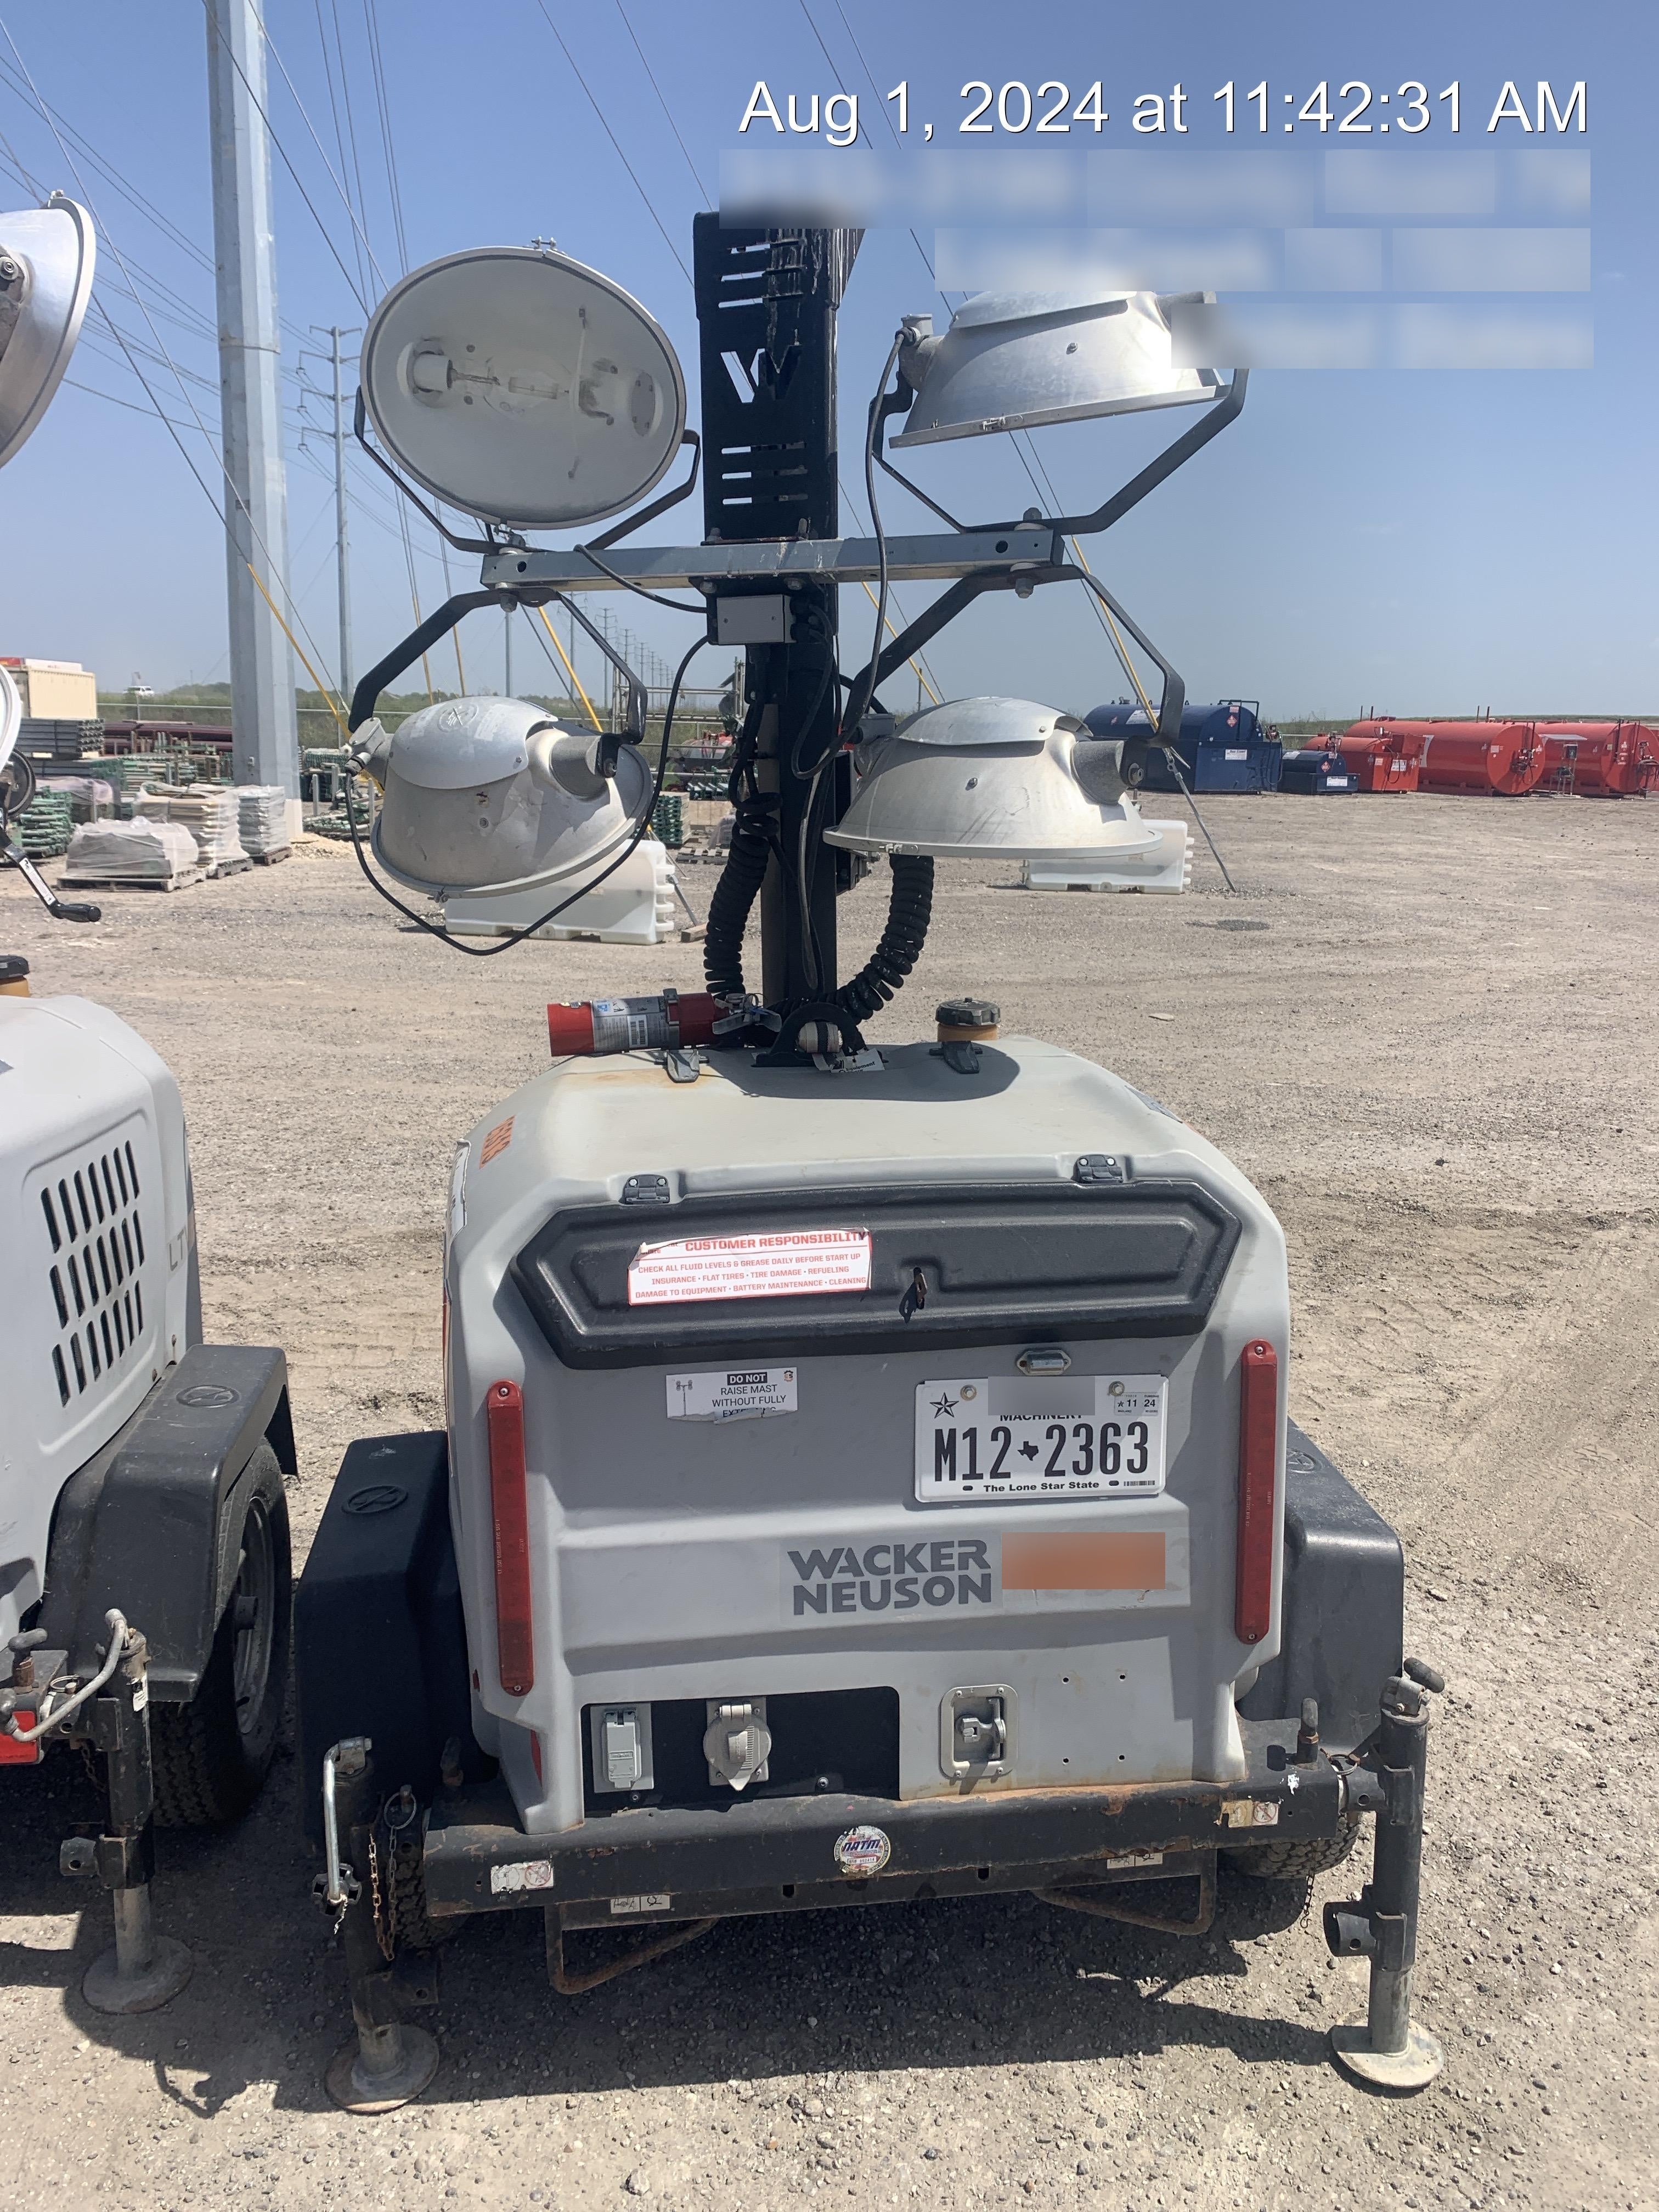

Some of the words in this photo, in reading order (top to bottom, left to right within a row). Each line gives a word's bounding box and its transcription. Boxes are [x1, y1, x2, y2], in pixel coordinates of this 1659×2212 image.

[170, 1229, 184, 1271] LT
[686, 1238, 755, 1251] CUSTOMER
[759, 1232, 866, 1247] RESPONSIBILITY
[741, 1259, 770, 1267] GREASE
[652, 1276, 696, 1285] INSURANCE
[770, 1269, 802, 1277] DAMAGE
[808, 1266, 849, 1274] REFUELING
[682, 1286, 727, 1295] EQUIPMENT
[733, 1283, 766, 1291] BATTERY
[769, 1280, 823, 1289] MAINTENANCE
[829, 1277, 866, 1285] CLEANING
[730, 1375, 743, 1384] DO
[746, 1374, 766, 1383] NOT
[721, 1386, 748, 1395] RAISE
[751, 1384, 777, 1393] MAST
[712, 1397, 756, 1407] WITHOUT
[759, 1395, 786, 1404] FULLY
[1126, 1399, 1137, 1407] 11
[1144, 1399, 1155, 1407] 24
[935, 1426, 1012, 1482] M12
[1044, 1421, 1148, 1478] 2363
[787, 1539, 992, 1581] WACKER
[793, 1572, 992, 1616] NEUSON
